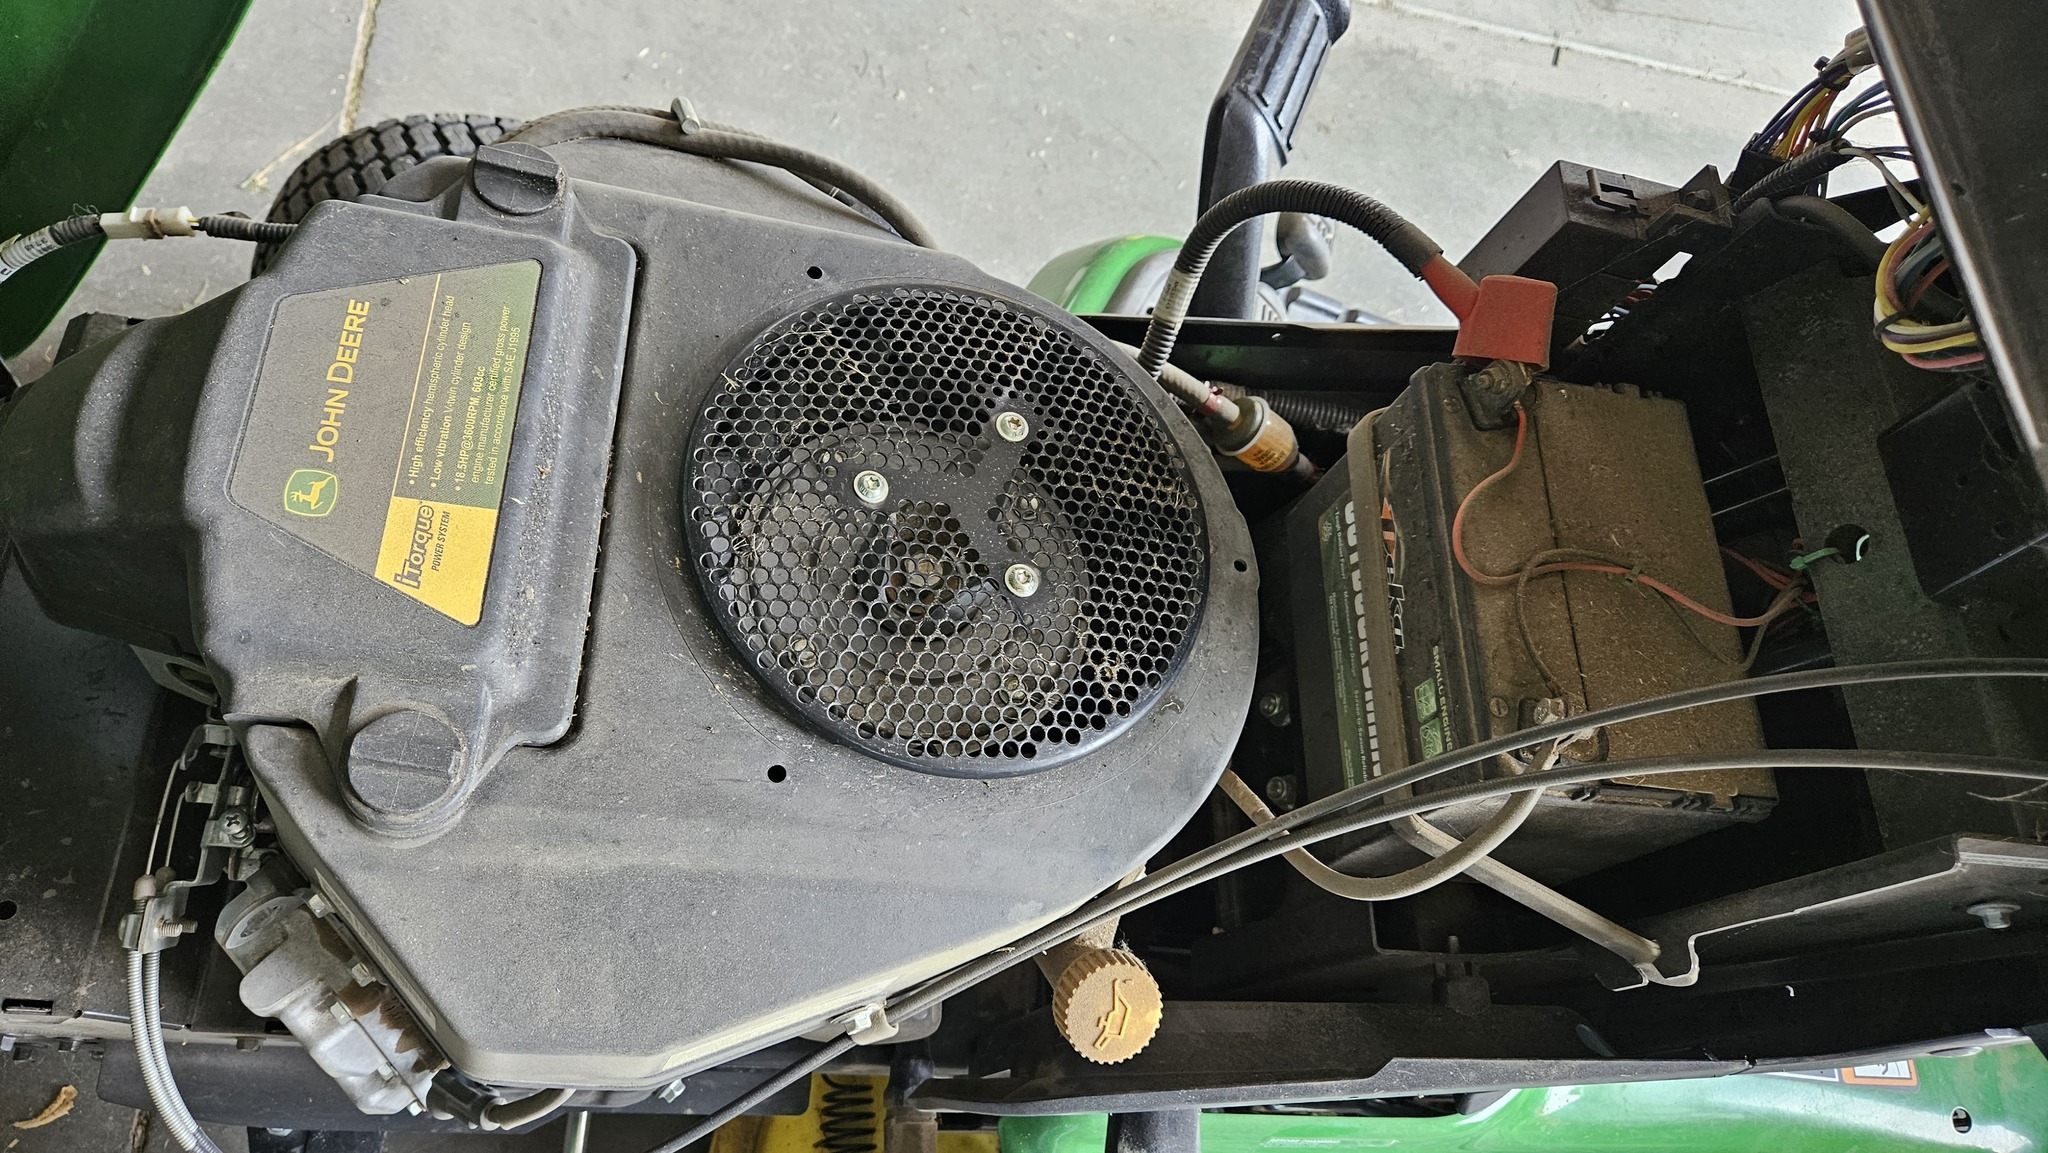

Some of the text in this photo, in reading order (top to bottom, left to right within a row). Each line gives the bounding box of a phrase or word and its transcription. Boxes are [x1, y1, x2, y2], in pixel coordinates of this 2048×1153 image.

[309, 299, 370, 462] JOHN DEERE
[408, 295, 454, 477] High efficiency hemispheric cylinder head
[430, 322, 472, 480] Low vibration V-twin cylinder design
[471, 306, 510, 483] engine manufacturer certified gross power
[472, 366, 485, 393] 603cc
[484, 327, 520, 485] tested in accordance with SAE J1995
[393, 505, 435, 589] iTorque
[431, 511, 451, 572] POWER SYSTEM
[1433, 645, 1443, 695] SMALL
